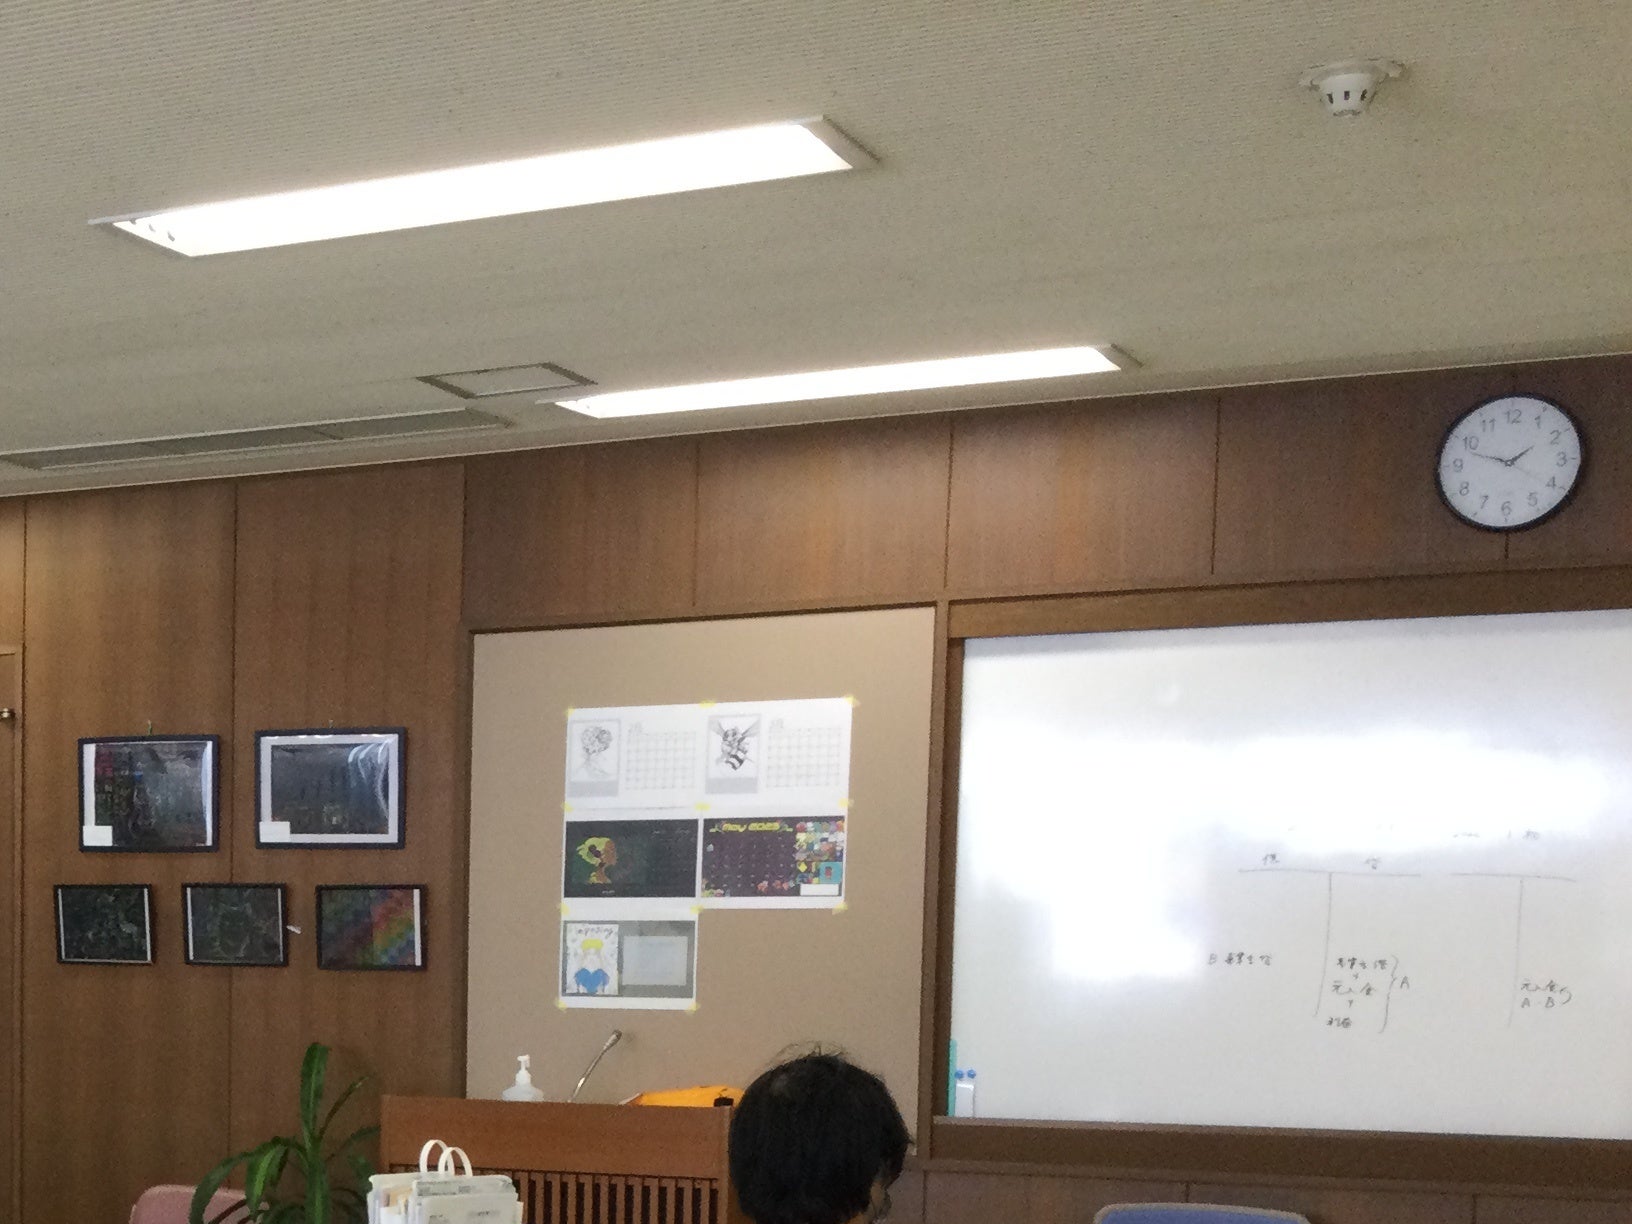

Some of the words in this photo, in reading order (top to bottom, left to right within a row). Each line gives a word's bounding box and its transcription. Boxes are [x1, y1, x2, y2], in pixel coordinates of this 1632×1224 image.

[1505, 409, 1522, 424] 12
[1534, 415, 1542, 429] 1
[1481, 418, 1496, 432] 11
[1462, 435, 1479, 450] 10
[1549, 429, 1562, 445] 2
[1452, 458, 1464, 472] 9
[1556, 451, 1567, 467] 3
[1459, 481, 1470, 496] 8
[1546, 476, 1556, 489] 4
[1479, 495, 1489, 509] 7
[1526, 492, 1538, 507] 5
[1501, 501, 1512, 516] 6
